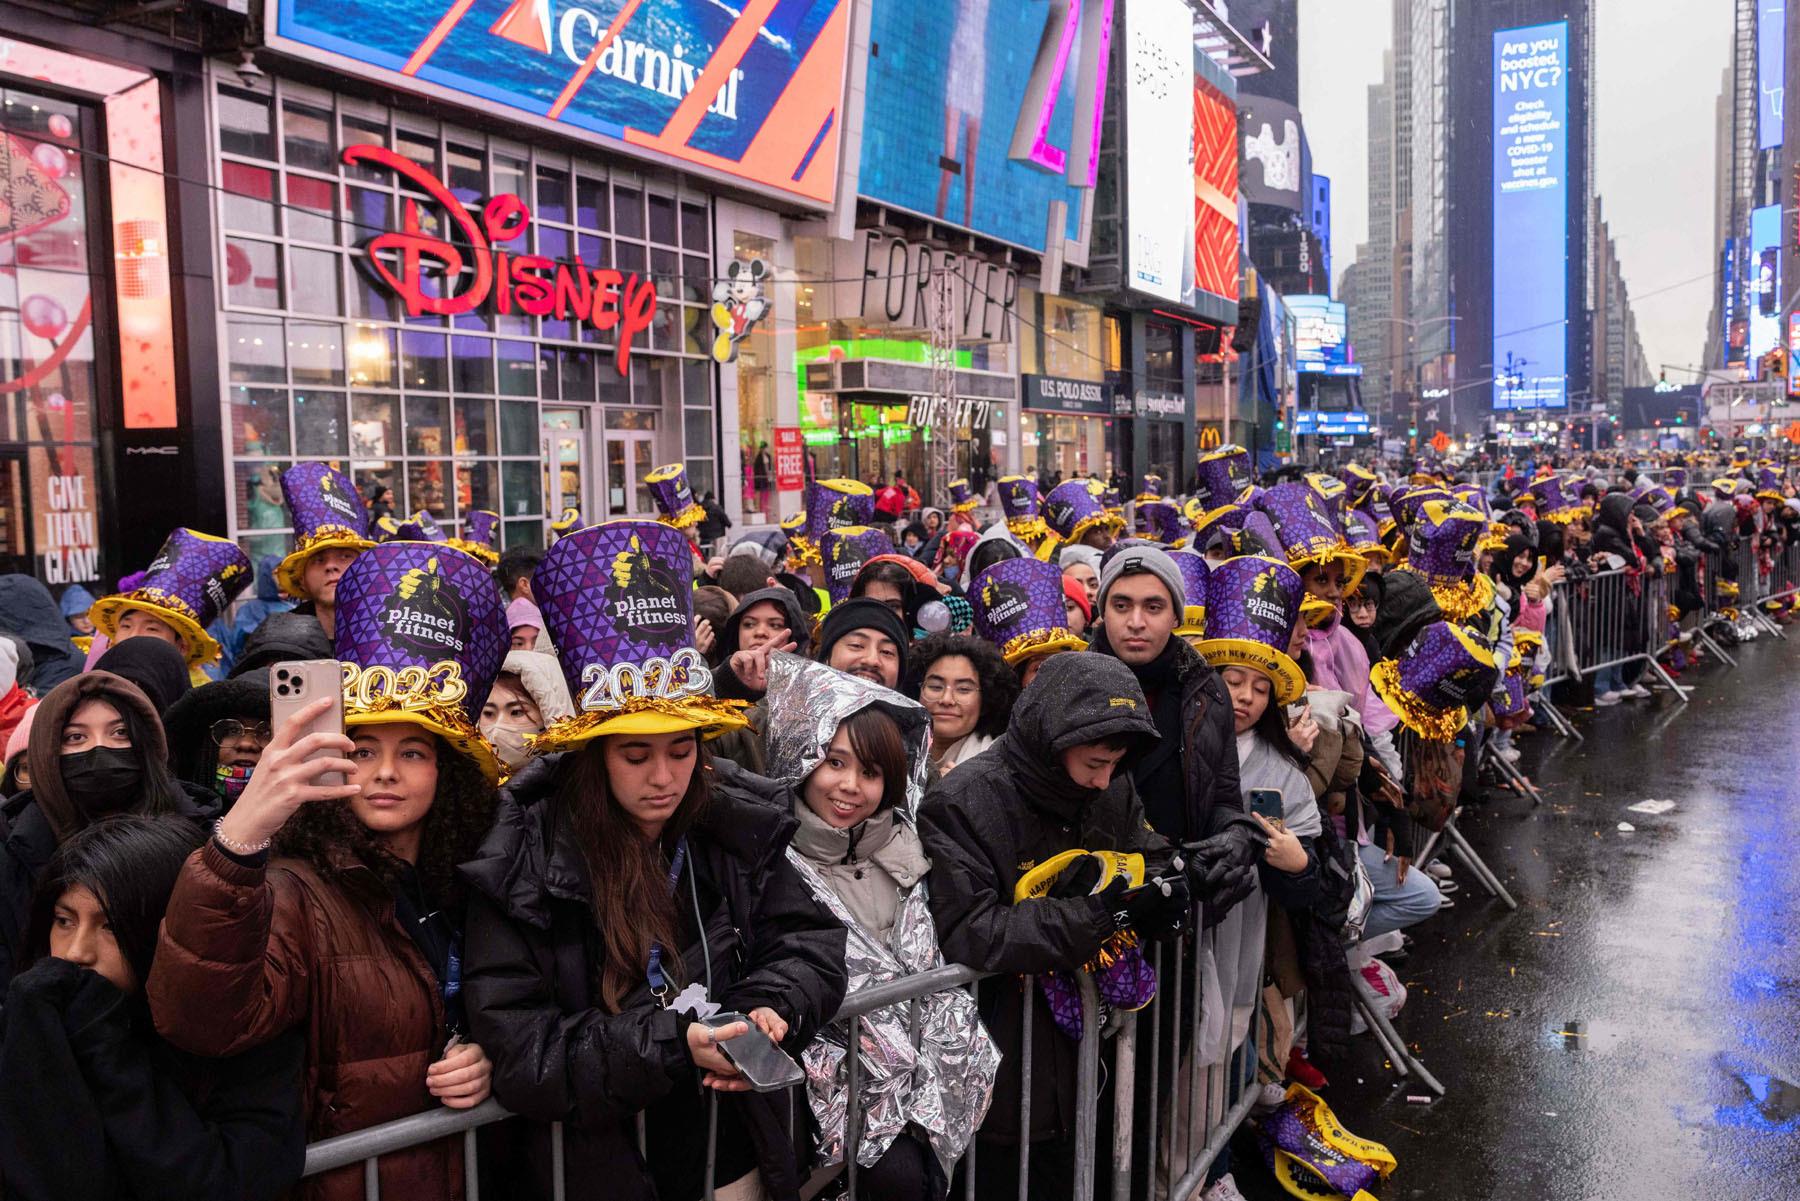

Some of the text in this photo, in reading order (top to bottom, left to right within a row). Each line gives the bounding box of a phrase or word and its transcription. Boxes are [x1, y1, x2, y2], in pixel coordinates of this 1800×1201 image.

[1502, 38, 1558, 56] Are you
[1501, 67, 1561, 92] NYC?
[1507, 142, 1553, 156] COVID-19
[1040, 379, 1056, 396] U.S.
[1057, 382, 1079, 399] POLO
[47, 475, 86, 511] GIVE
[44, 511, 93, 548] THEM
[44, 547, 100, 584] GLAM!
[832, 560, 861, 576] planet
[835, 568, 860, 580] fitne
[614, 595, 677, 618] planet
[627, 610, 687, 627] fitness
[987, 597, 1018, 622] planet
[993, 601, 1029, 625] fitness
[1247, 597, 1285, 617] planet
[1251, 605, 1288, 629] fitness
[387, 606, 455, 633] planet
[394, 620, 464, 651] fitness
[1203, 649, 1226, 662] HAPPY
[1229, 649, 1246, 659] NEW
[1248, 653, 1269, 667] YEAR
[341, 659, 468, 712] 2023
[581, 647, 713, 711] 2023
[1029, 869, 1060, 896] HAPPY
